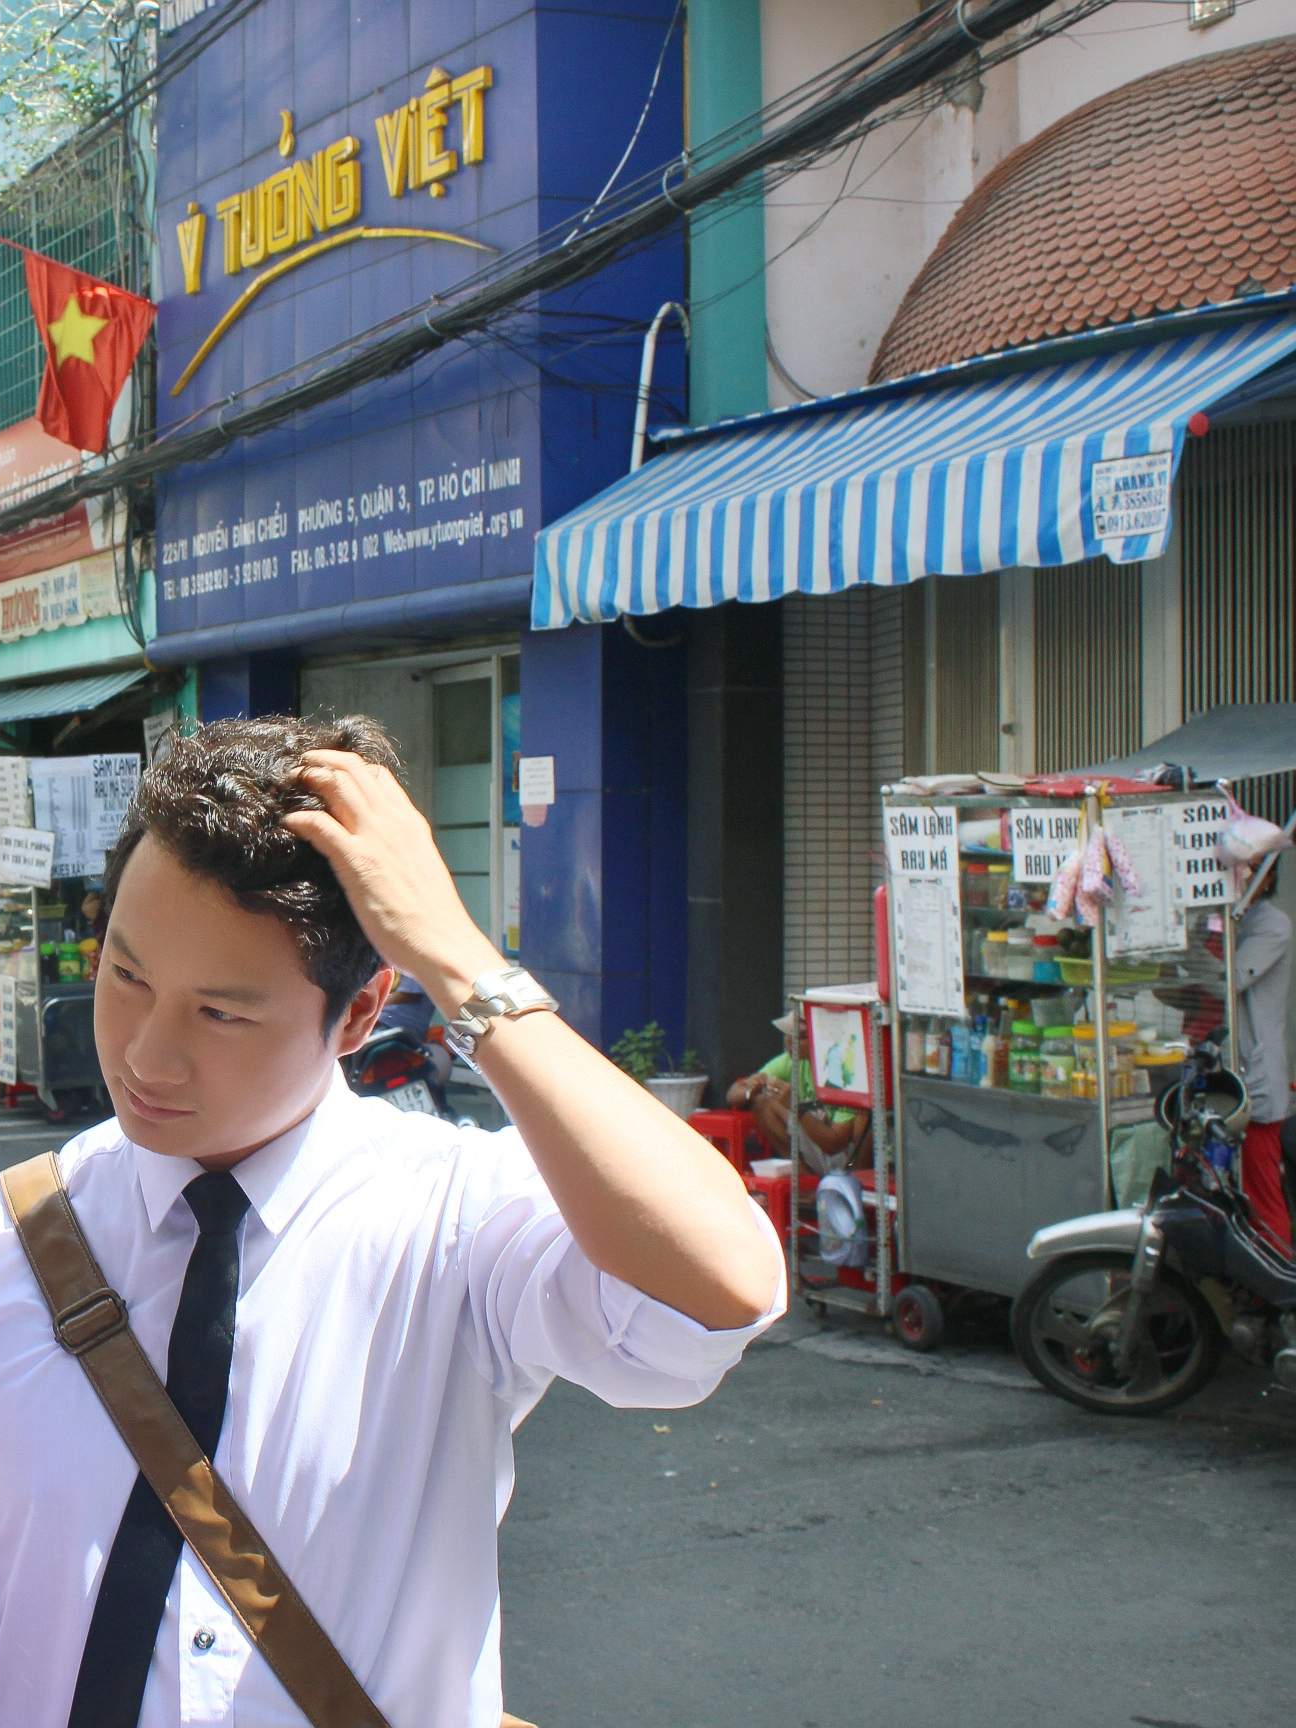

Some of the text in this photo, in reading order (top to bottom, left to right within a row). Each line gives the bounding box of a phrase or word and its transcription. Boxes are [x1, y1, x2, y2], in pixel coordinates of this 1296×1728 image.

[360, 484, 394, 520] QUẬN
[398, 484, 410, 514] 3,
[419, 478, 435, 506] TP.
[489, 457, 521, 491] MINH
[1183, 804, 1226, 823] SÂM
[890, 814, 953, 839] SÂM LẠNH
[1016, 816, 1044, 839] SÂM
[901, 846, 948, 871] RAU MÁ
[1025, 854, 1051, 876] RAU
[1193, 879, 1224, 899] MÁ
